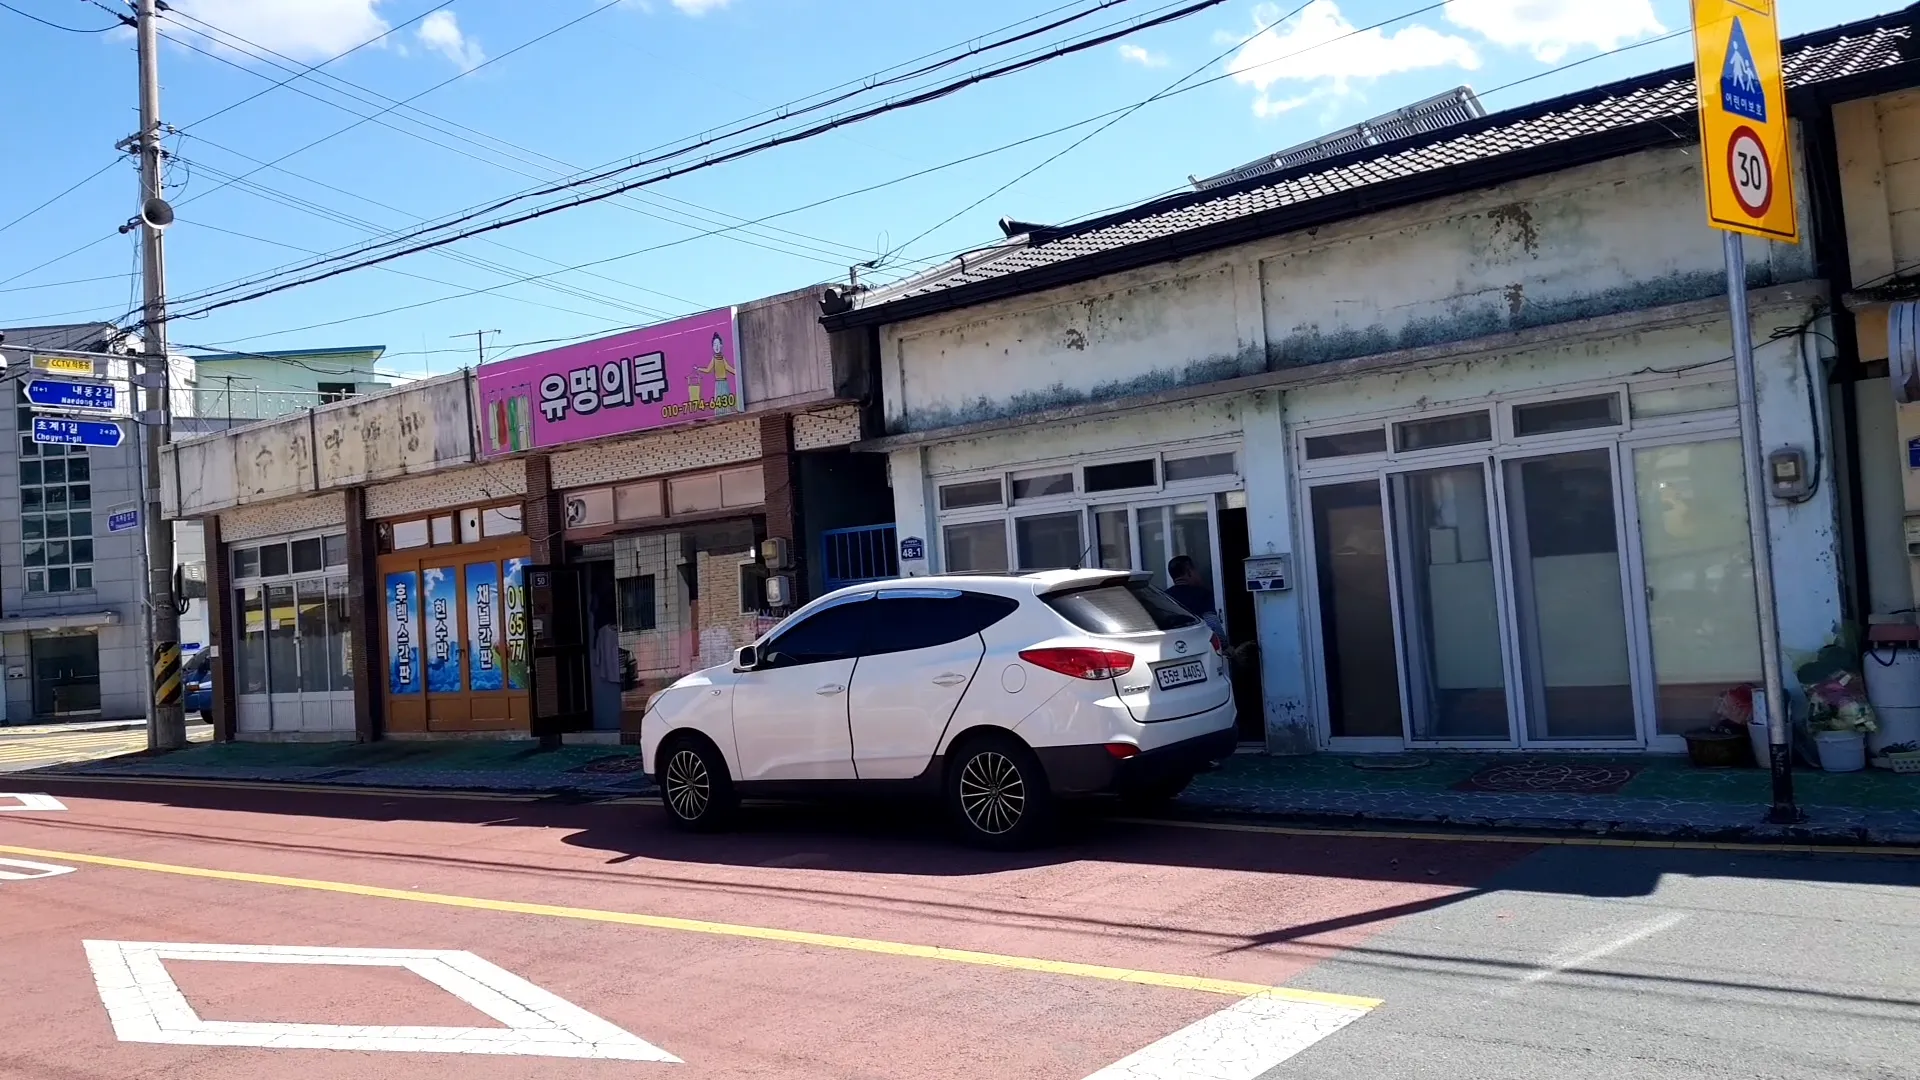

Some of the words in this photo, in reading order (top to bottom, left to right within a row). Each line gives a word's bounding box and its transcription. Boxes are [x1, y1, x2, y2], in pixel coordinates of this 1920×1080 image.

[1725, 91, 1763, 116] 어린이보호
[1737, 151, 1762, 190] 30
[51, 359, 70, 368] CCTV
[72, 385, 113, 399] 내동2길
[540, 351, 667, 421] 유명의류
[61, 396, 93, 406] Naedong
[661, 394, 736, 419] 010-7174-6430
[36, 420, 78, 434] 초계1길
[902, 547, 922, 558] 48-1
[395, 583, 411, 684] 후렉스간판
[434, 599, 449, 661] 현수막
[477, 584, 493, 670] 채널간판
[1182, 665, 1202, 680] 4405
